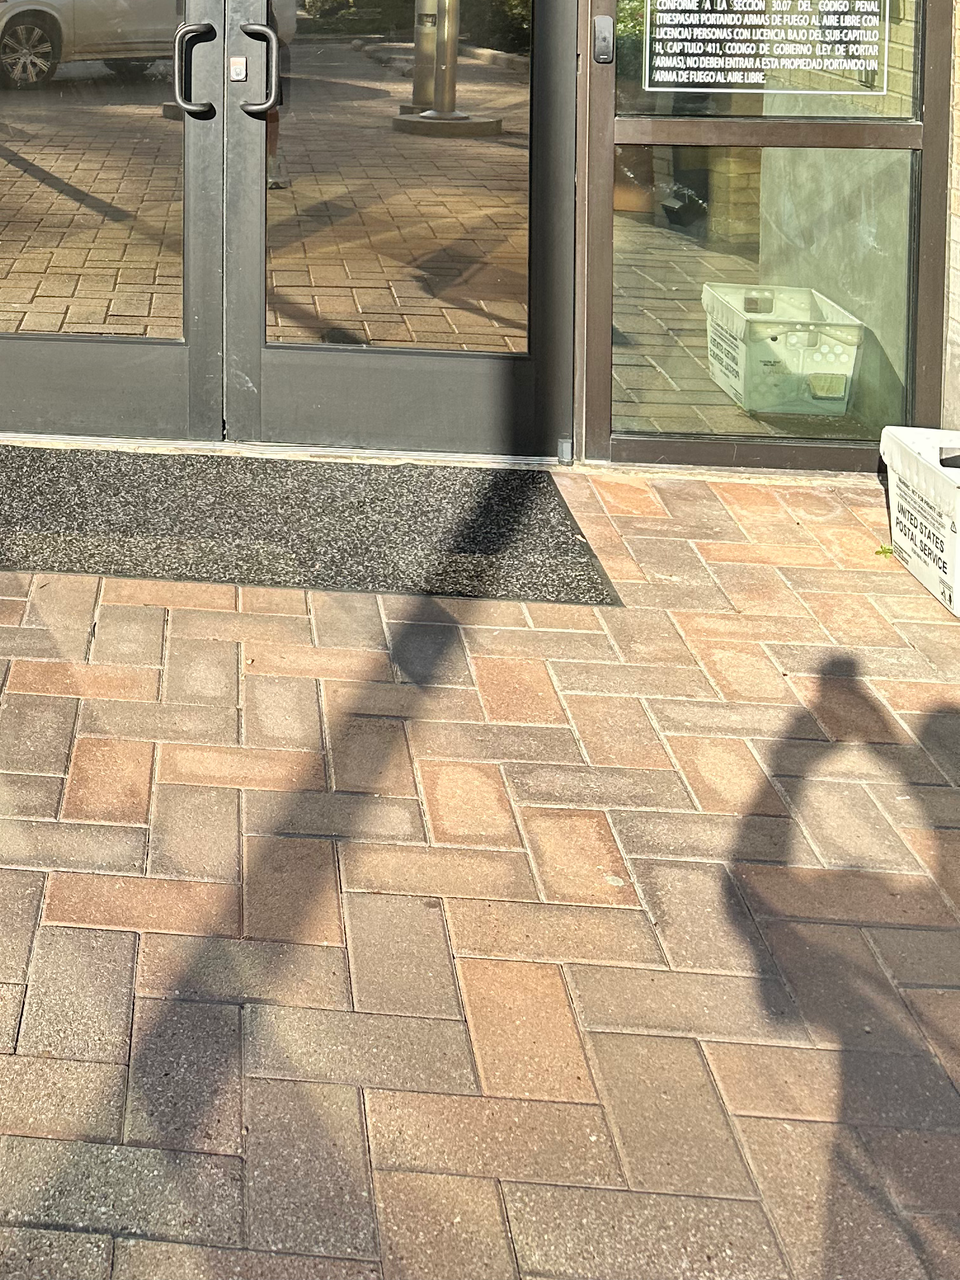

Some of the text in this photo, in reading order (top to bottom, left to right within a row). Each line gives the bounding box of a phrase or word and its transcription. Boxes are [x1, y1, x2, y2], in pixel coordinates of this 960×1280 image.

[657, 0, 699, 10] CONFORME
[772, 1, 792, 11] 30.07
[798, 1, 812, 11] DEL
[855, 1, 879, 11] PENAL
[656, 13, 879, 26] (TRESPASAR PORTANDO ARMAS FUEGO AIRE LIBRE CON
[693, 28, 823, 40] PERSONAS CON LICENCIA BAJO DEL
[726, 43, 878, 55] CODIGO DE GOBIERNO PORTAR
[687, 57, 878, 70] NO DEBEN ENTRAR ESTA PROPIEDAD PORTANDO UN
[655, 71, 743, 82] ARMA FUEGO AIRE
[897, 501, 918, 530] UNITED
[919, 521, 945, 553] STATES
[896, 517, 919, 550] POSTAL
[919, 540, 948, 575] SERVICE
